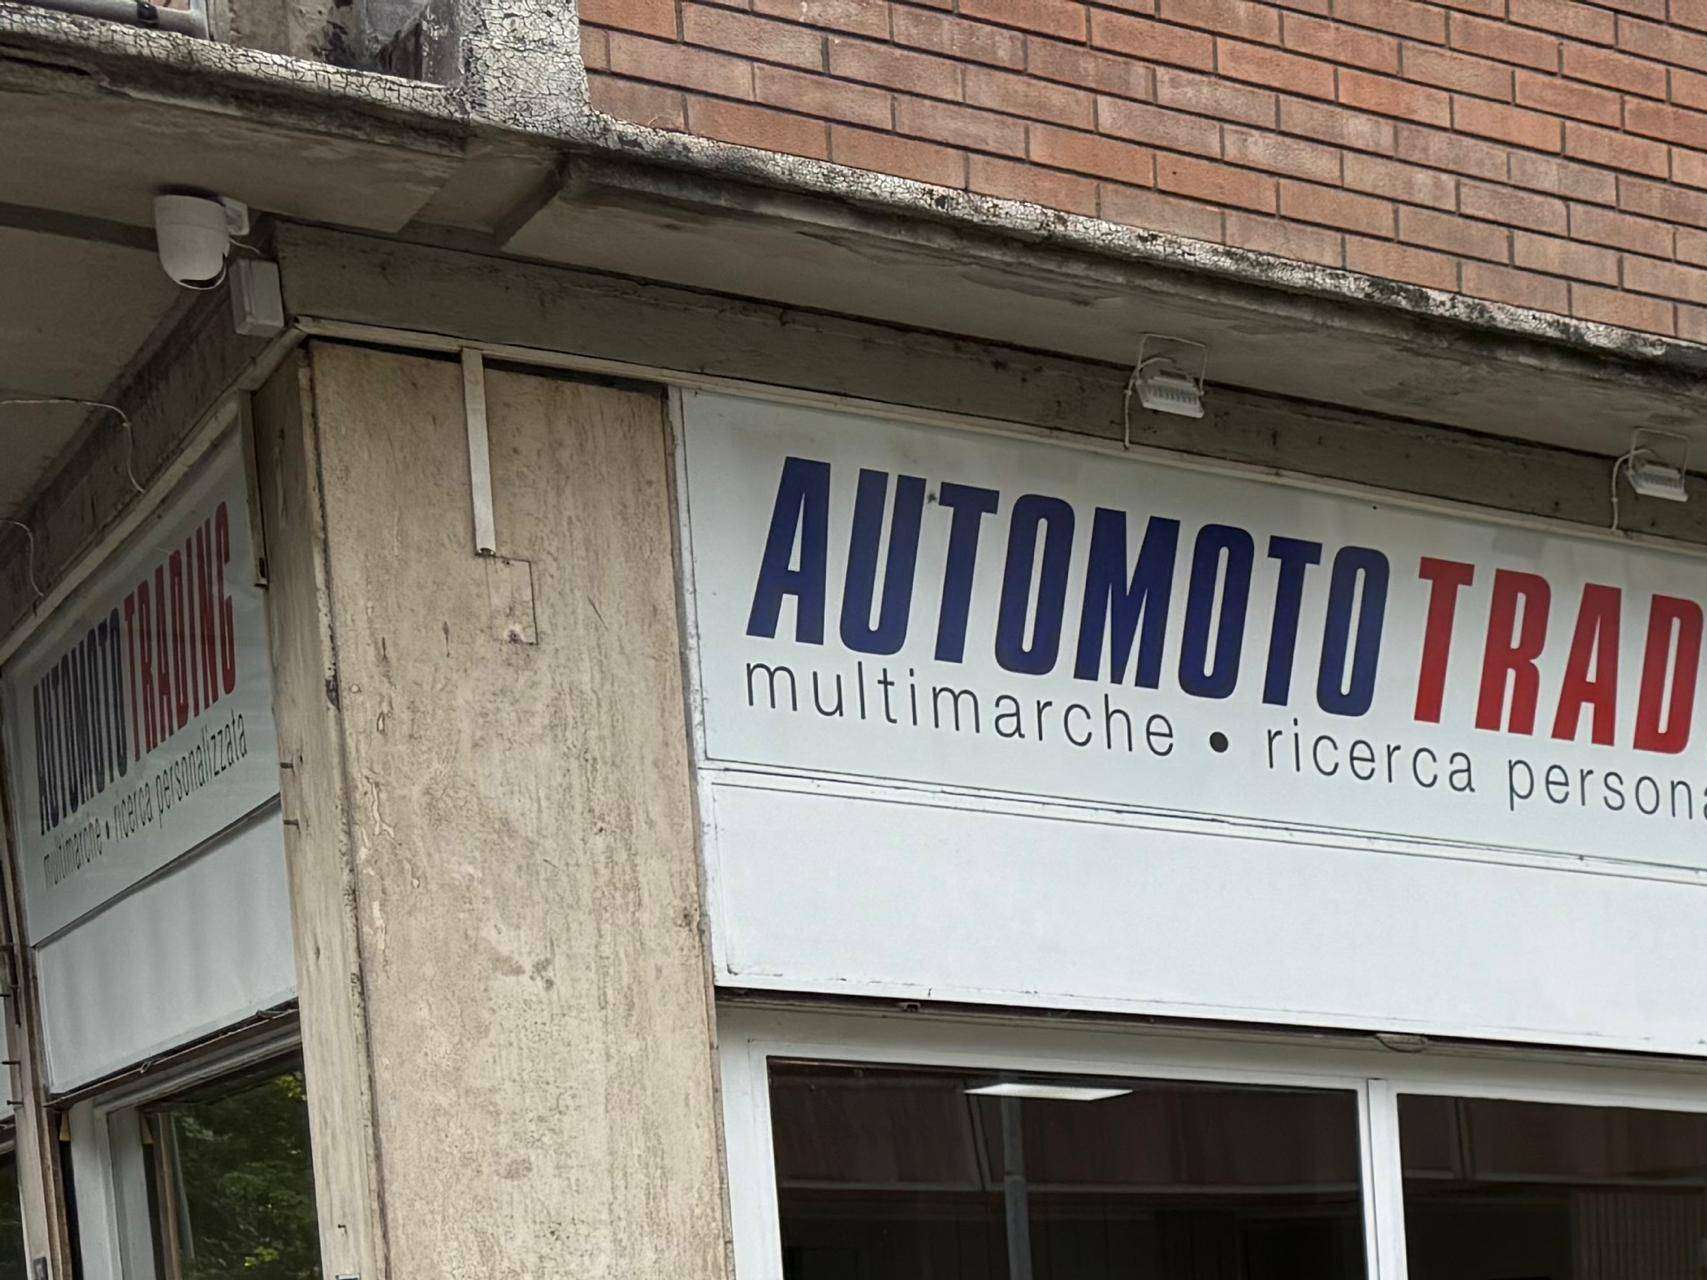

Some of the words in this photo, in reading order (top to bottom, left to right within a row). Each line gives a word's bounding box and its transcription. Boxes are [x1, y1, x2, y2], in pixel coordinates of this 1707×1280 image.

[155, 709, 248, 830] personalizzata
[745, 652, 1176, 758] multimarche
[1265, 718, 1478, 796] ricerca
